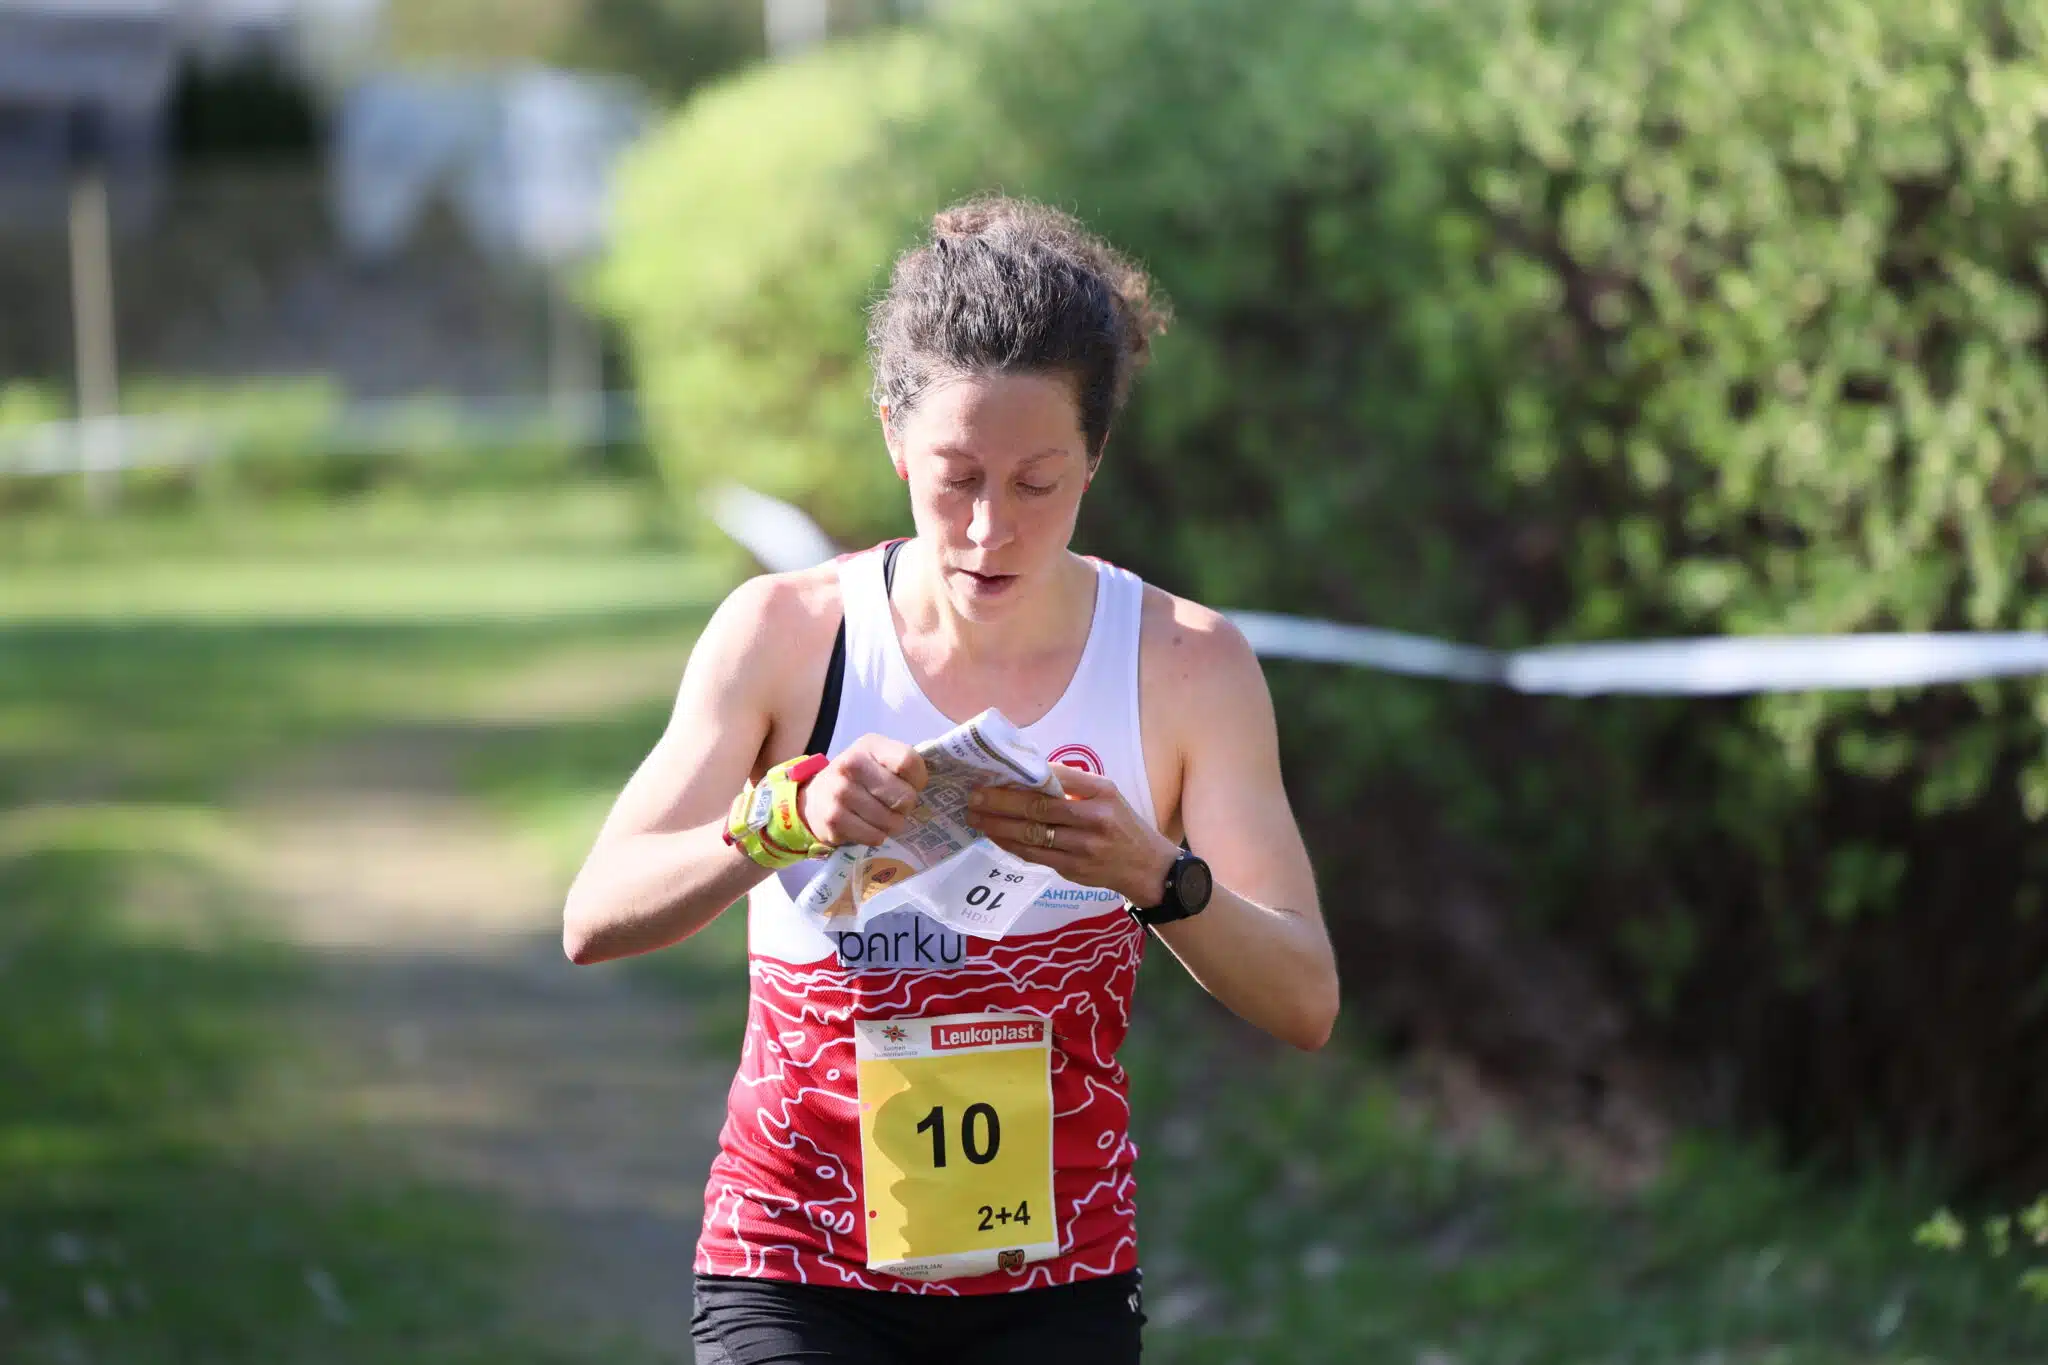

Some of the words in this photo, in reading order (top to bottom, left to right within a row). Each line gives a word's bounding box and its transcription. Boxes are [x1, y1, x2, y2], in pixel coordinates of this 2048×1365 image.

[988, 868, 1001, 879] 4
[965, 885, 1005, 911] 10
[1039, 888, 1120, 902] AHITAPIOLA
[940, 1023, 1035, 1045] Leukoplast
[917, 1102, 1001, 1168] 10
[977, 1200, 1031, 1232] 2+4
